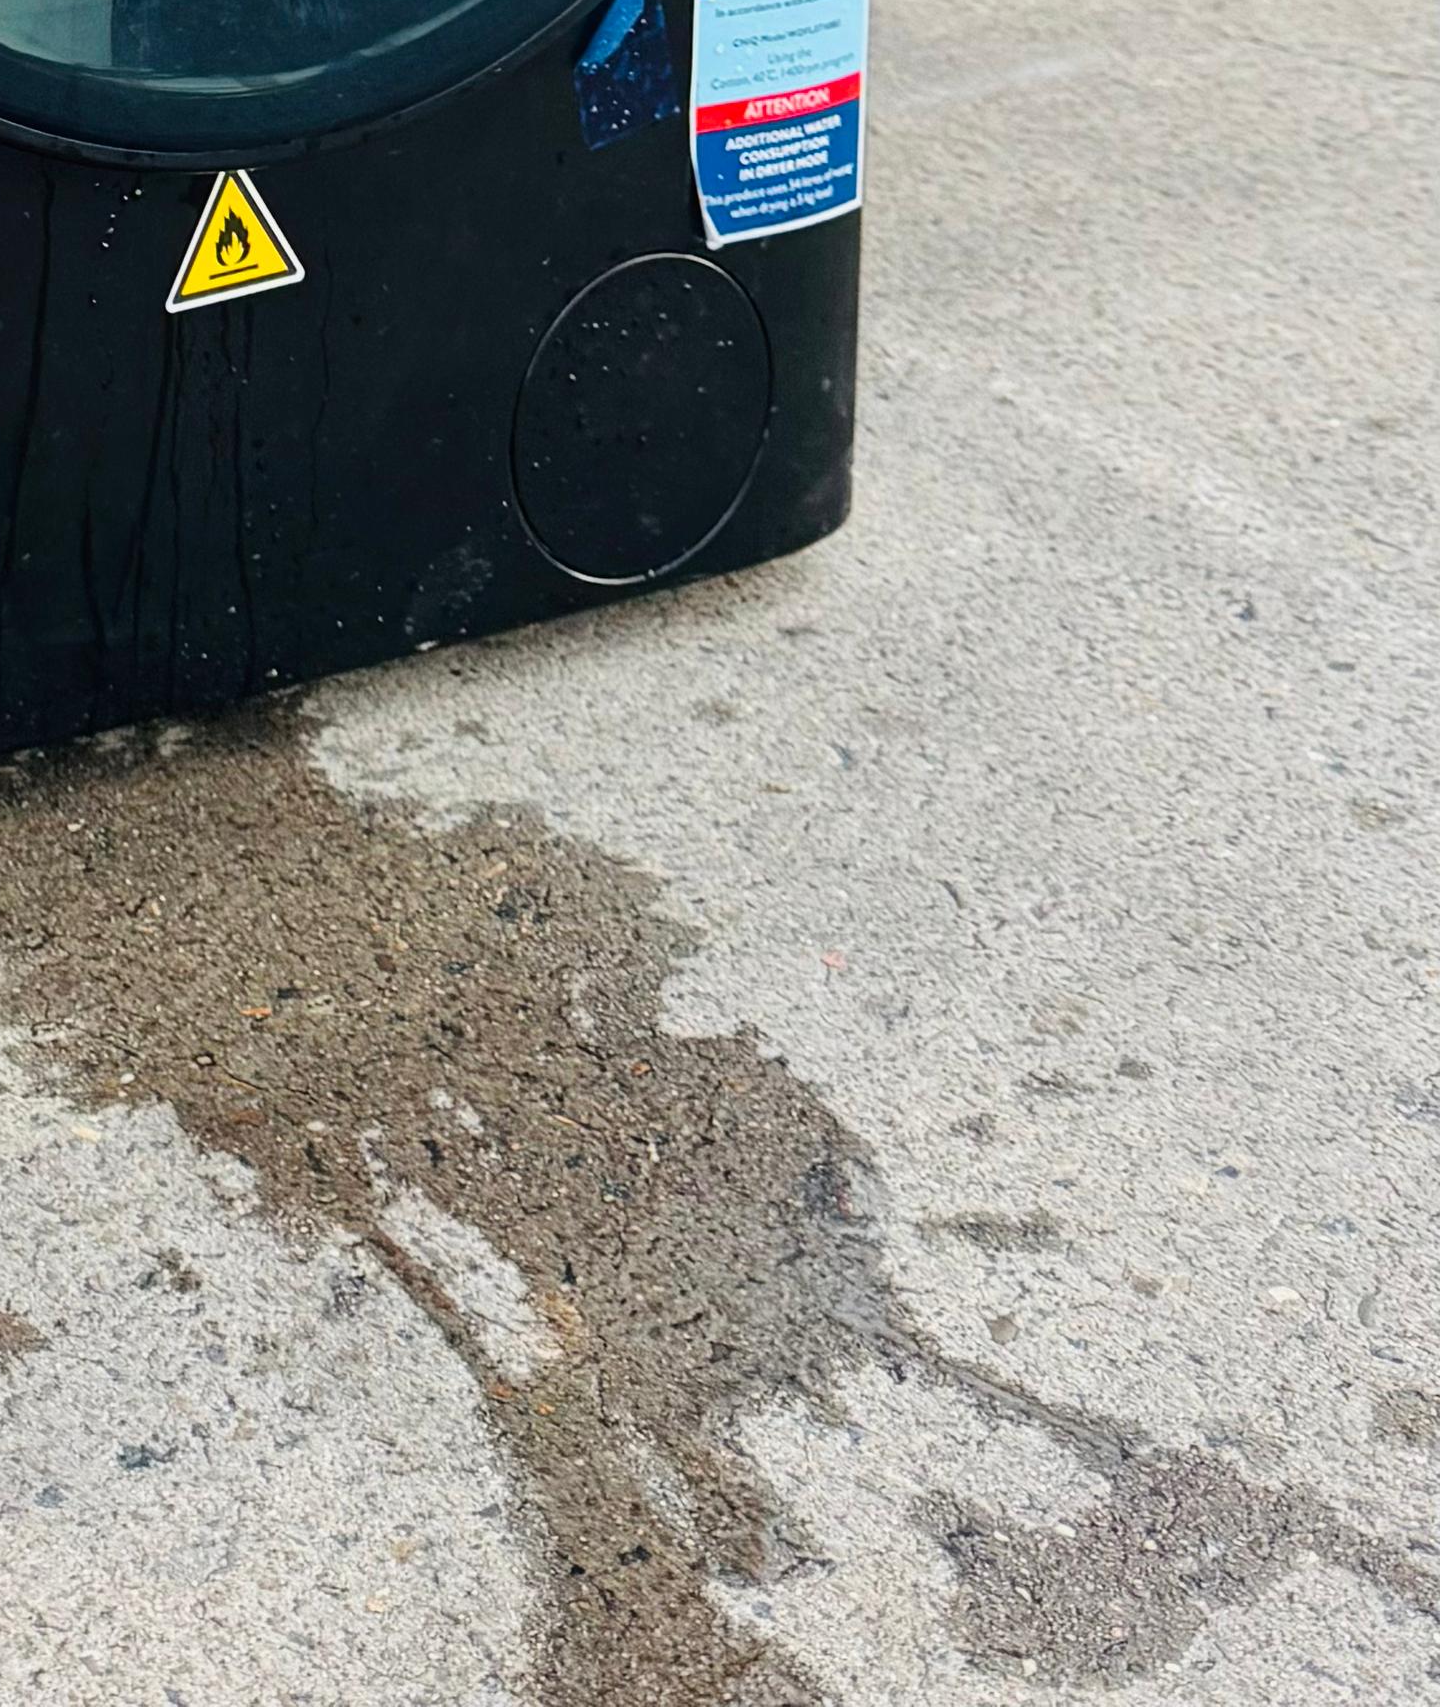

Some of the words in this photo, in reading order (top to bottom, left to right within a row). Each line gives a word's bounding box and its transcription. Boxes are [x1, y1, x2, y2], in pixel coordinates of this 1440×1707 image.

[744, 87, 830, 119] ATTENTION
[725, 125, 804, 151] ADDITIONAL
[803, 114, 841, 135] WATER
[739, 135, 830, 165] CONSUMPTION
[739, 168, 755, 182] IN
